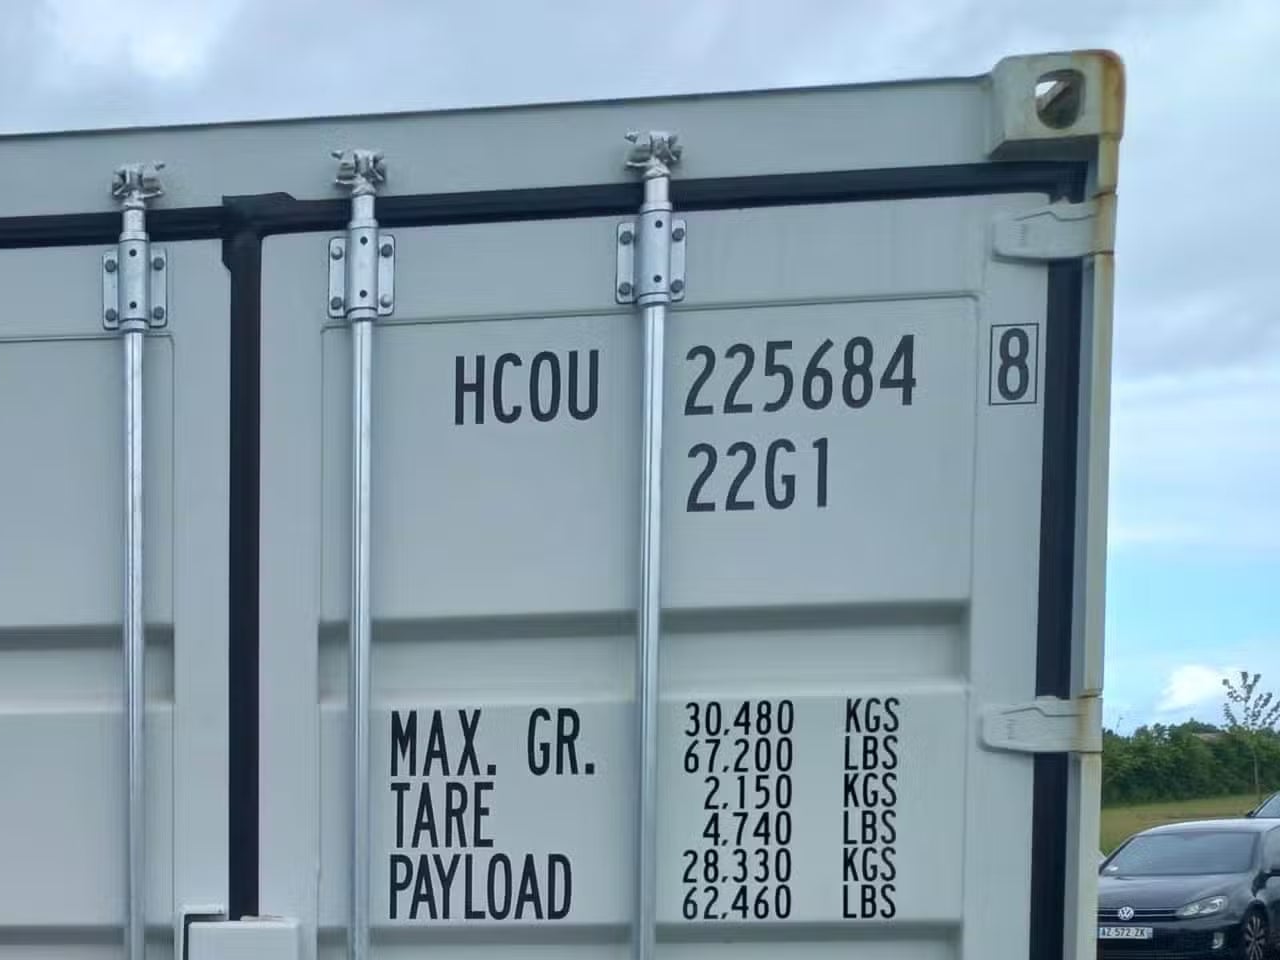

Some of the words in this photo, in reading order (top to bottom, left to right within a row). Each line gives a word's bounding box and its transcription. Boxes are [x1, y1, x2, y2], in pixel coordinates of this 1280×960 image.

[454, 349, 599, 426] HCOU
[684, 334, 917, 416] 225684
[997, 327, 1030, 401] 8
[686, 437, 828, 513] 22G1
[685, 699, 794, 737] 30,480
[845, 697, 900, 733] KGS
[390, 709, 497, 777] MAX.
[527, 707, 595, 776] GR.
[684, 736, 793, 774] 67,200
[844, 734, 898, 771] LBS
[703, 773, 793, 810] 2,150
[843, 772, 897, 808] KGS
[390, 781, 494, 849] TARE
[702, 810, 792, 847] 4,740
[843, 809, 897, 845] LBS
[682, 847, 792, 884] 28,330
[843, 846, 897, 882] KGS
[389, 852, 572, 921] PAYLOAD
[682, 884, 792, 920] 62,460
[842, 883, 896, 919] LBS
